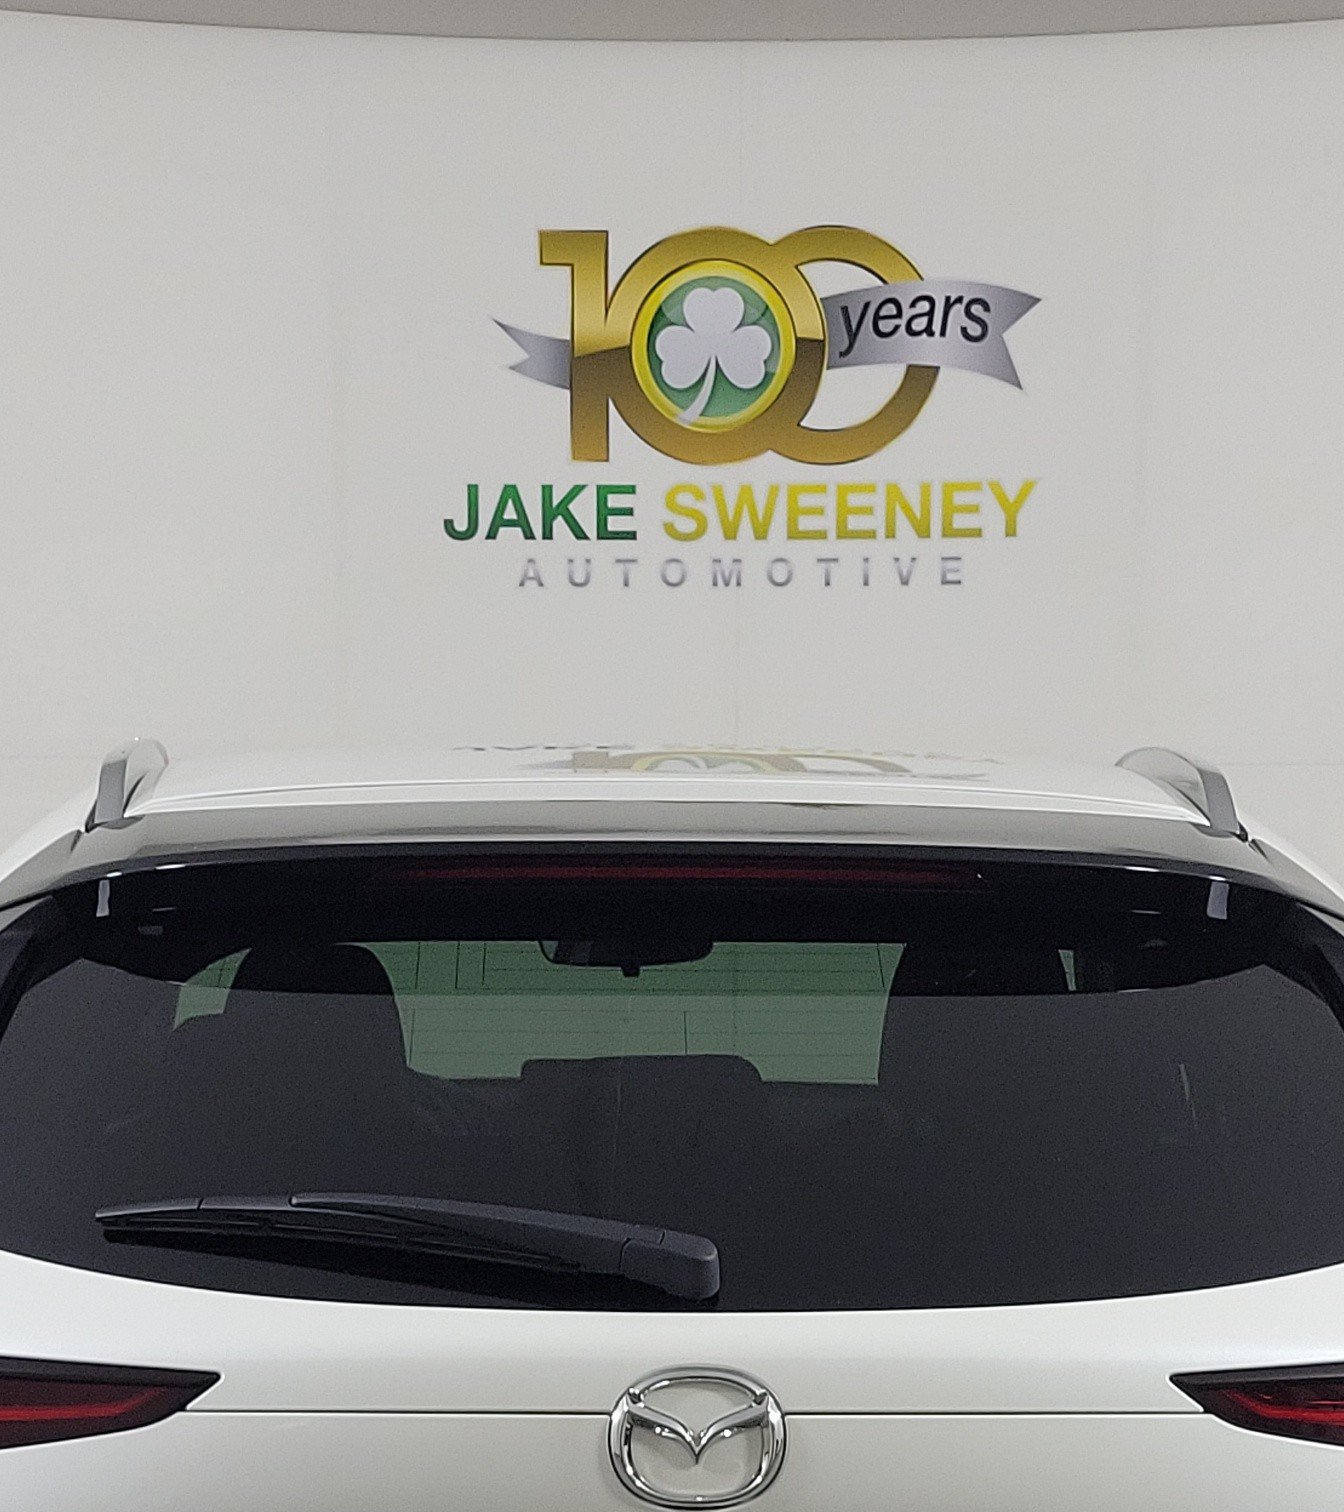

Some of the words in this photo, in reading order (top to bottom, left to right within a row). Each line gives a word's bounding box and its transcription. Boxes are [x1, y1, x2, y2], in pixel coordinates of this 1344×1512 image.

[538, 225, 939, 465] 100
[837, 291, 992, 359] years
[442, 483, 638, 541] JAKE
[661, 478, 1038, 542] SWEENEY
[517, 556, 964, 588] AUTOMOTIVE
